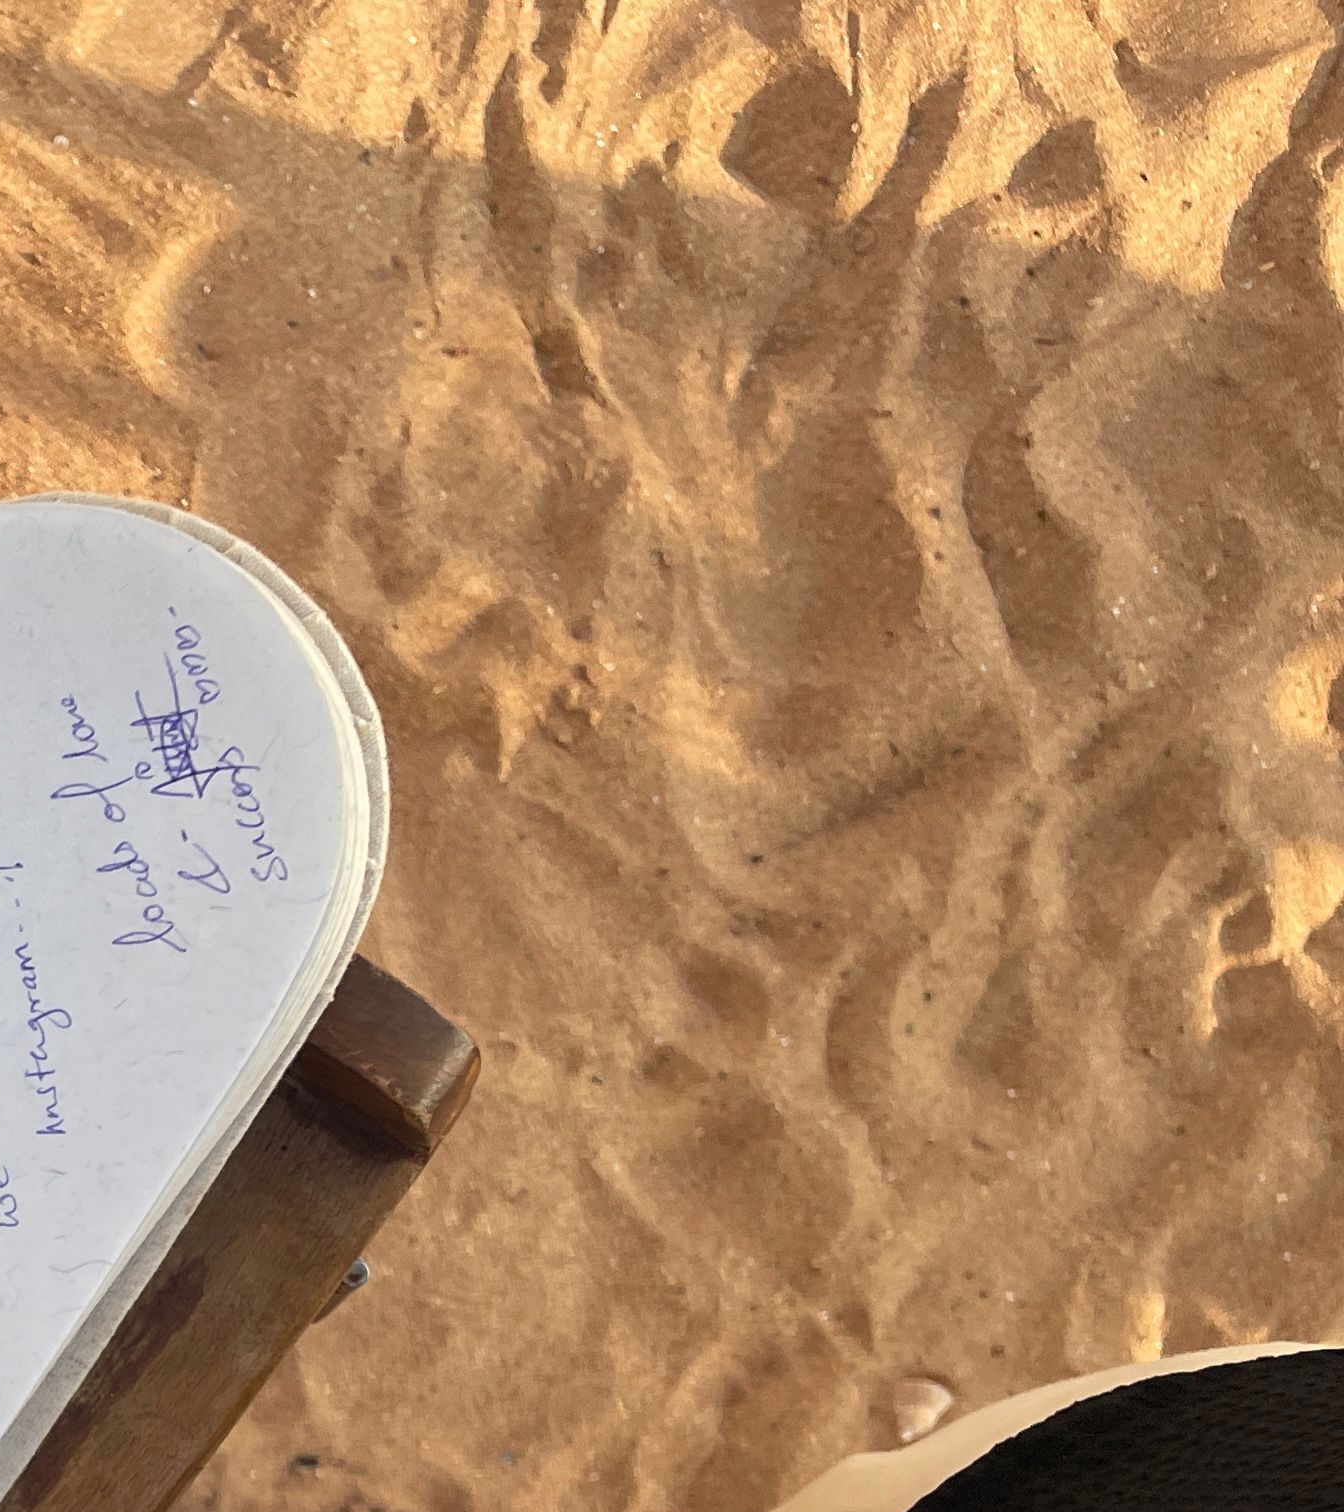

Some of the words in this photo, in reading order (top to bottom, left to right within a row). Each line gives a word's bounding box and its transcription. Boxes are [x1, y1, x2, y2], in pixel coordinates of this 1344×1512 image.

[60, 692, 109, 764] love
[49, 774, 135, 824] of
[95, 840, 188, 954] loads
